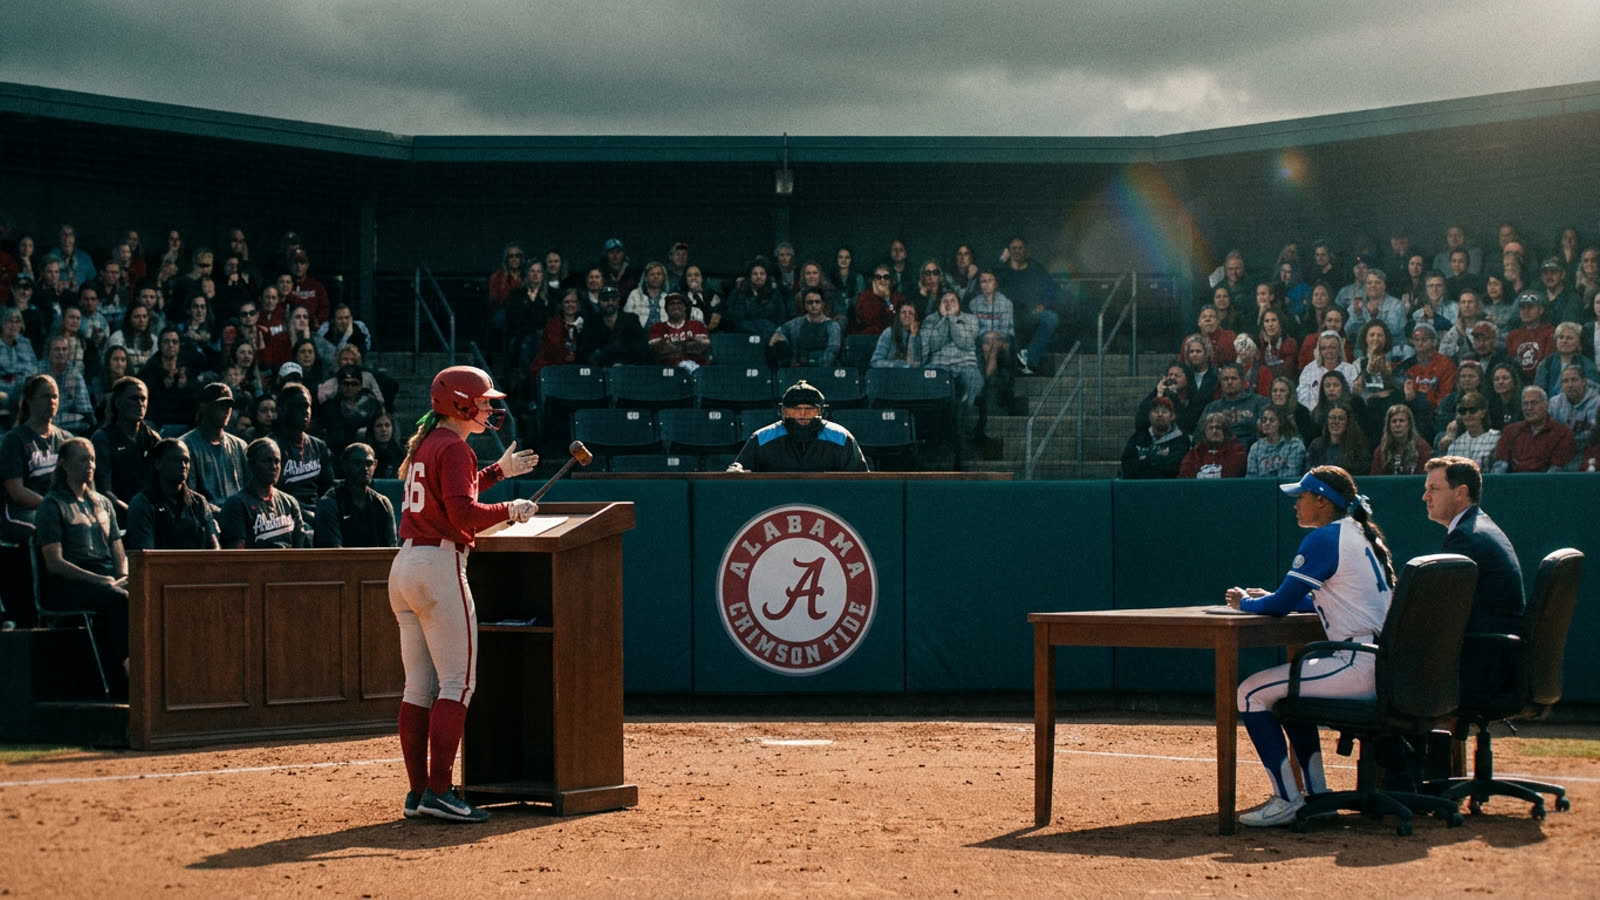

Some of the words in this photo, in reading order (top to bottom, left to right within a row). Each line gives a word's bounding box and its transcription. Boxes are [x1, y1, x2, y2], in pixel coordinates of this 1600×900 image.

[729, 515, 866, 580] ALABAMA
[761, 556, 828, 621] A
[728, 600, 821, 666] CRIMSON
[823, 600, 867, 654] TIDE
